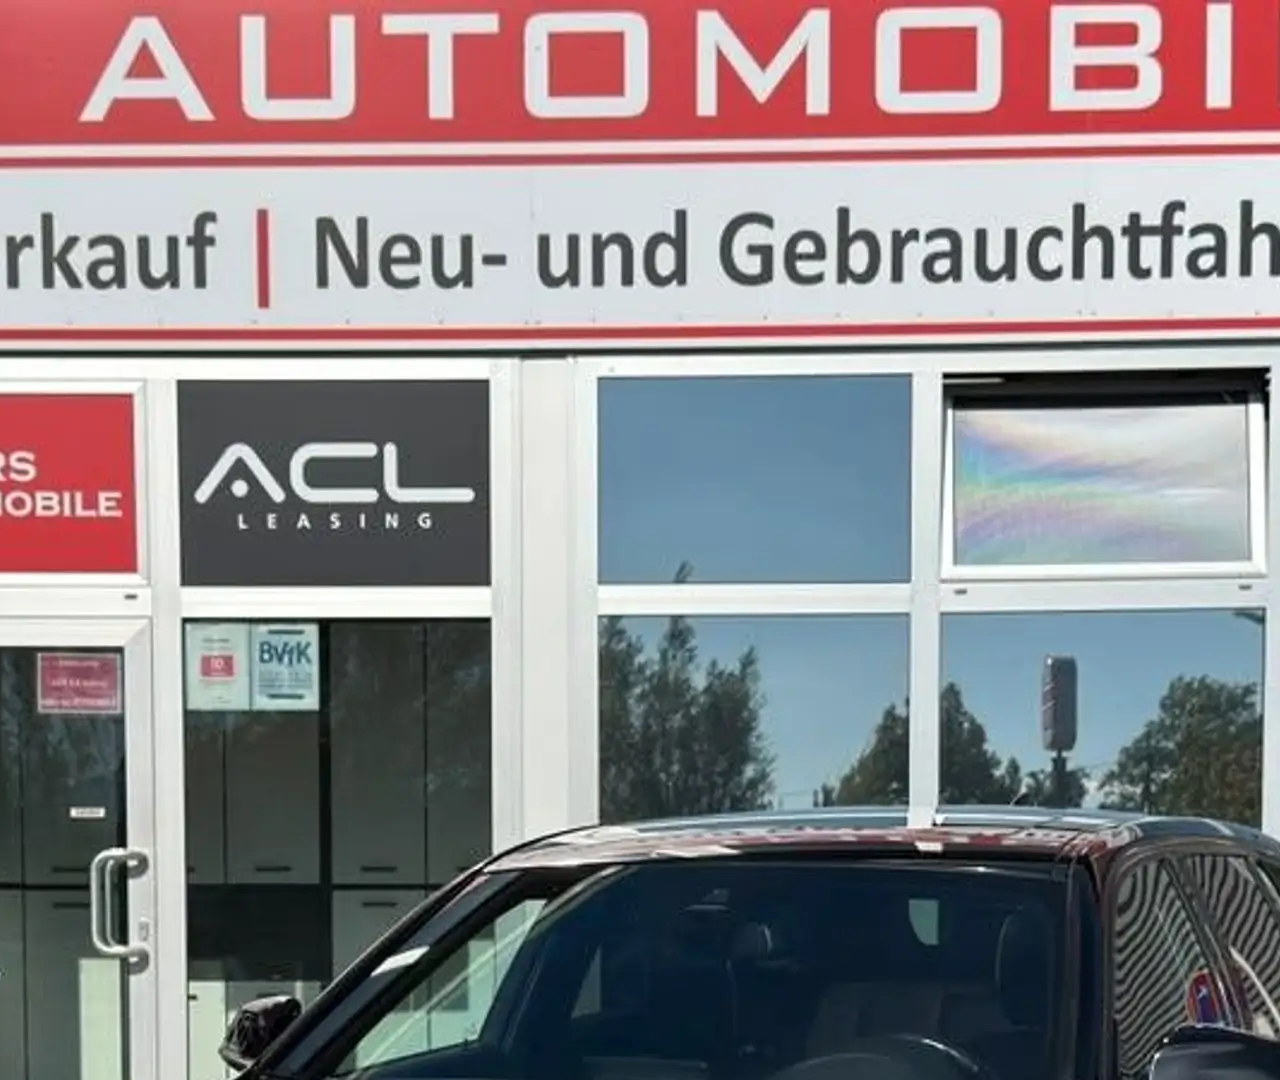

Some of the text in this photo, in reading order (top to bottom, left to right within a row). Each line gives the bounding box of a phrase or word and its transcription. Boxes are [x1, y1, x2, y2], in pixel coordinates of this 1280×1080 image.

[315, 216, 507, 290] Neu-
[537, 209, 687, 289] und
[193, 441, 476, 504] ACL
[237, 512, 432, 530] LEASING
